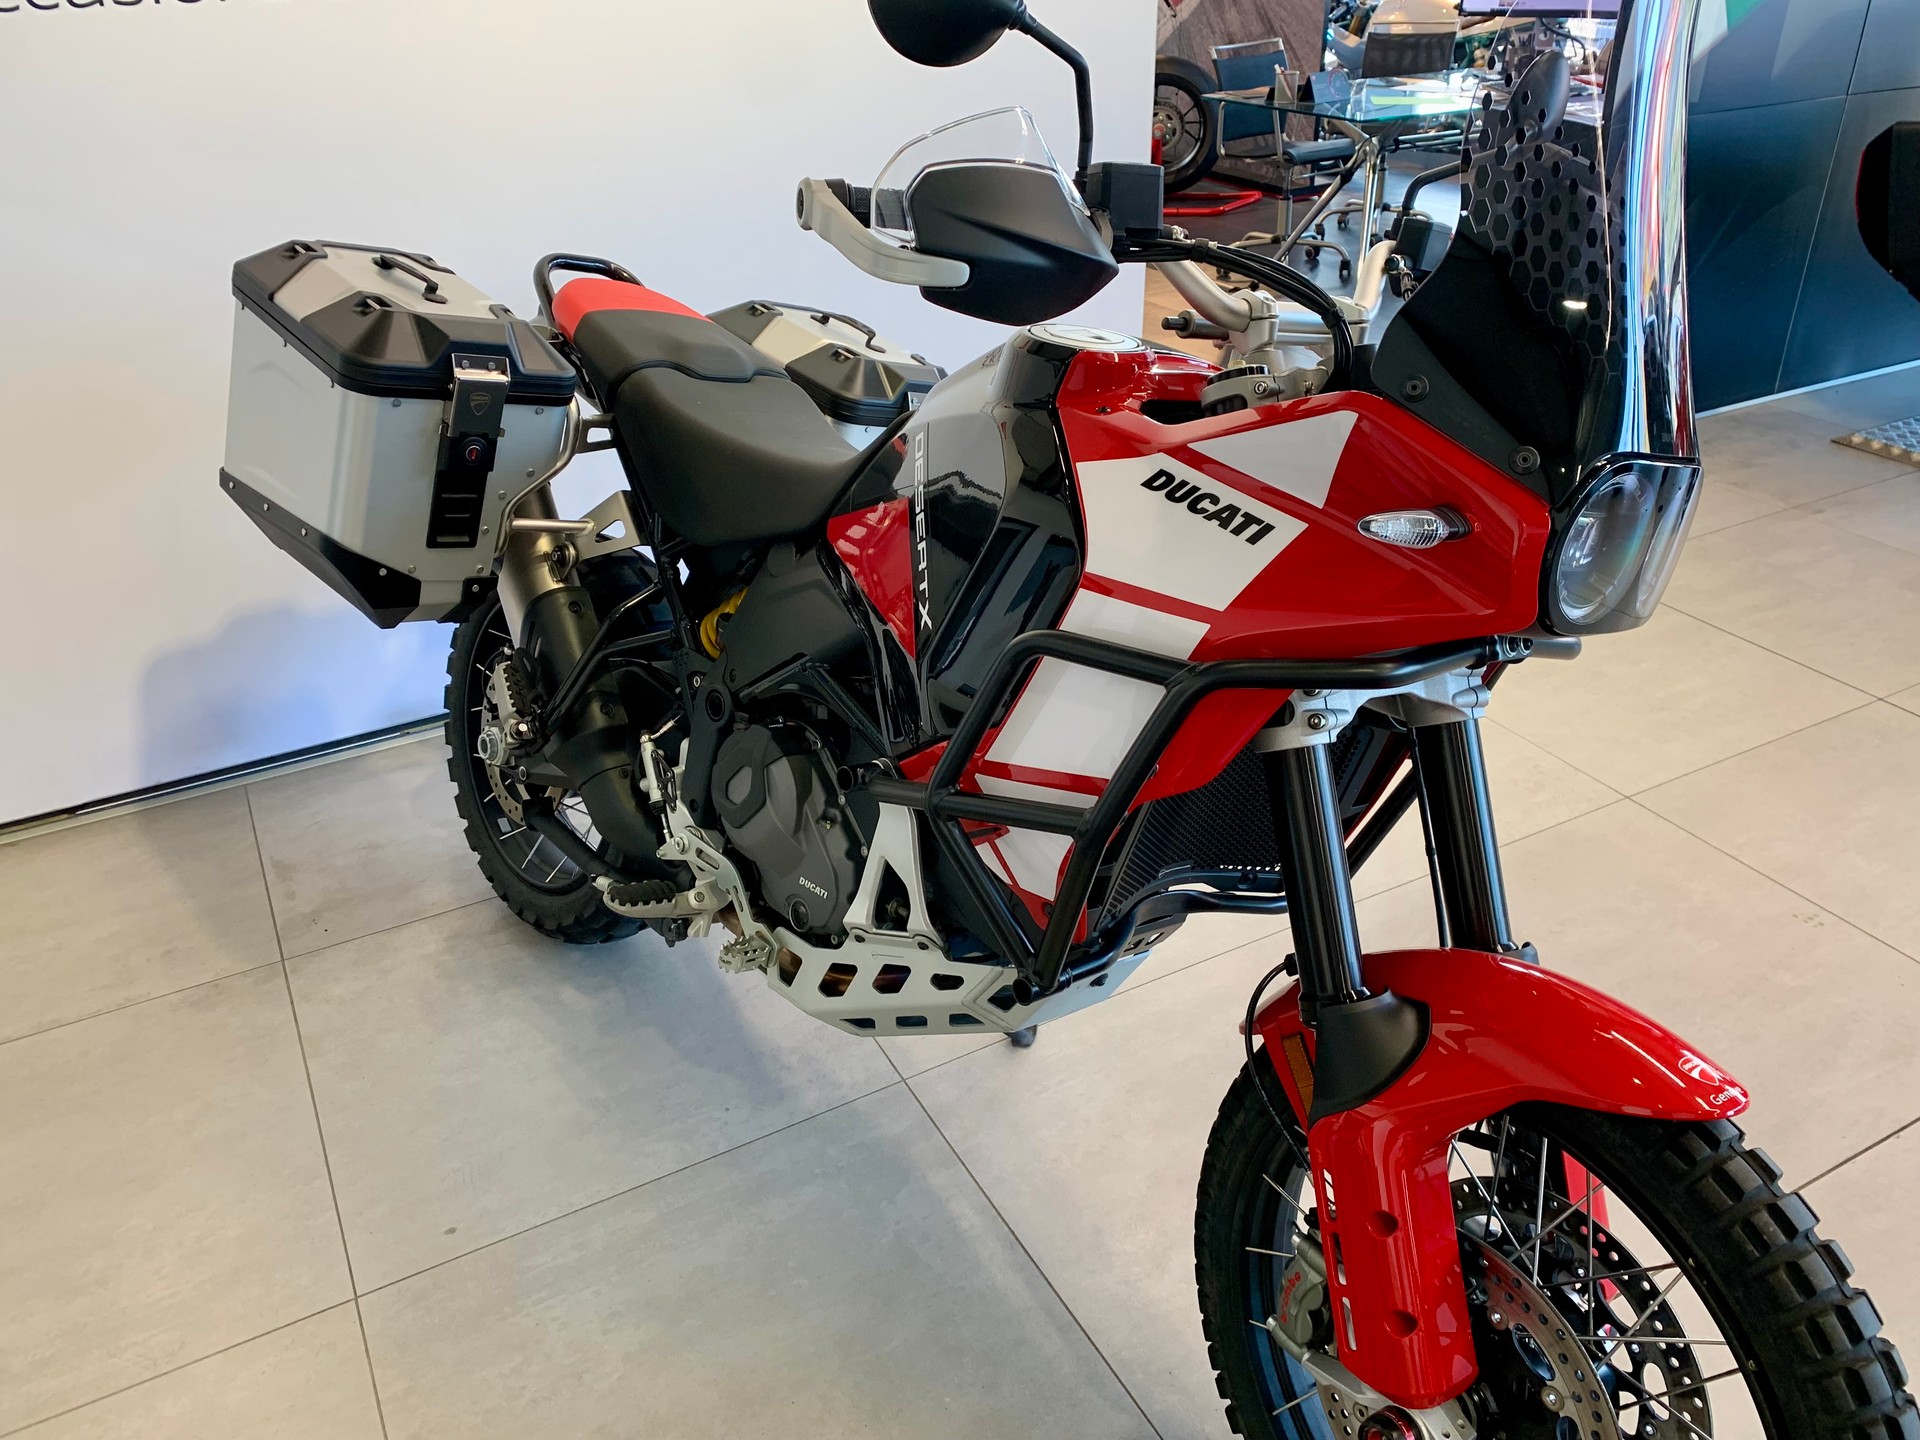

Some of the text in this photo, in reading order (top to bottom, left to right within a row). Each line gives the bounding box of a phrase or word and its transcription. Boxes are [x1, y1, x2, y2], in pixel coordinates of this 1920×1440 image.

[914, 431, 933, 631] DESERTX
[1139, 468, 1277, 546] DUCATI
[799, 876, 828, 899] DUCATI
[1709, 1086, 1744, 1105] Gen
